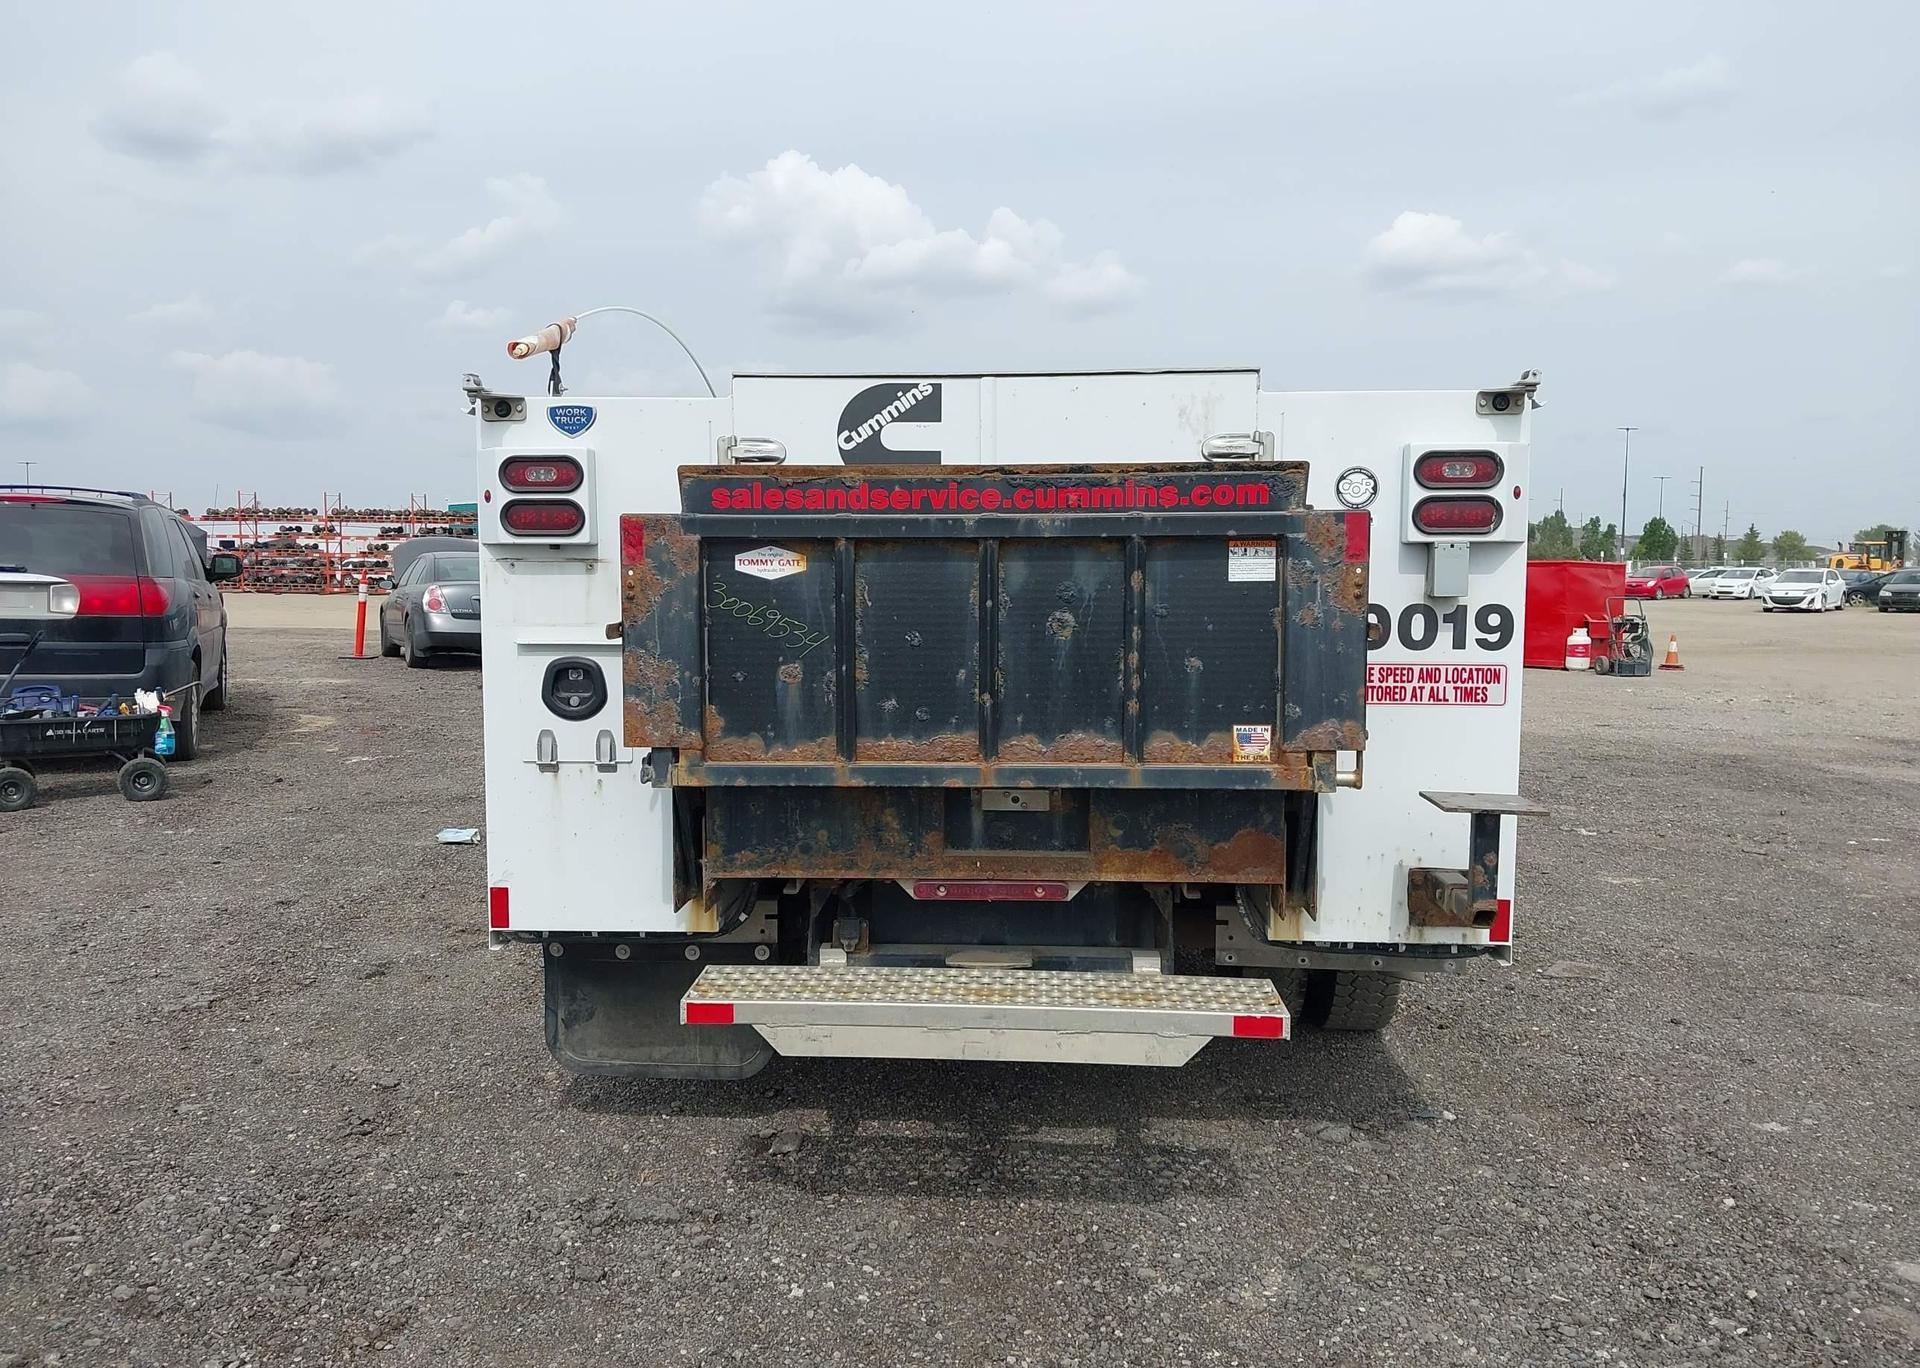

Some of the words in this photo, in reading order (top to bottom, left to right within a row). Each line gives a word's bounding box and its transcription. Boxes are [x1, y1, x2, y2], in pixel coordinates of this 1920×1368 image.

[555, 408, 587, 416] WORK
[555, 416, 588, 424] TRUCK
[838, 382, 933, 451] Cummins
[711, 481, 1270, 510] salesandservice.cummins.com
[737, 558, 775, 567] TOMMY
[778, 558, 802, 567] GATE
[708, 582, 830, 658] 30069534
[1378, 667, 1415, 684] SPEED
[1417, 668, 1442, 684] AND
[1445, 668, 1501, 685] LOCATION
[1410, 686, 1425, 702] AT
[1428, 686, 1450, 703] ALL
[1452, 687, 1488, 704] TIMES
